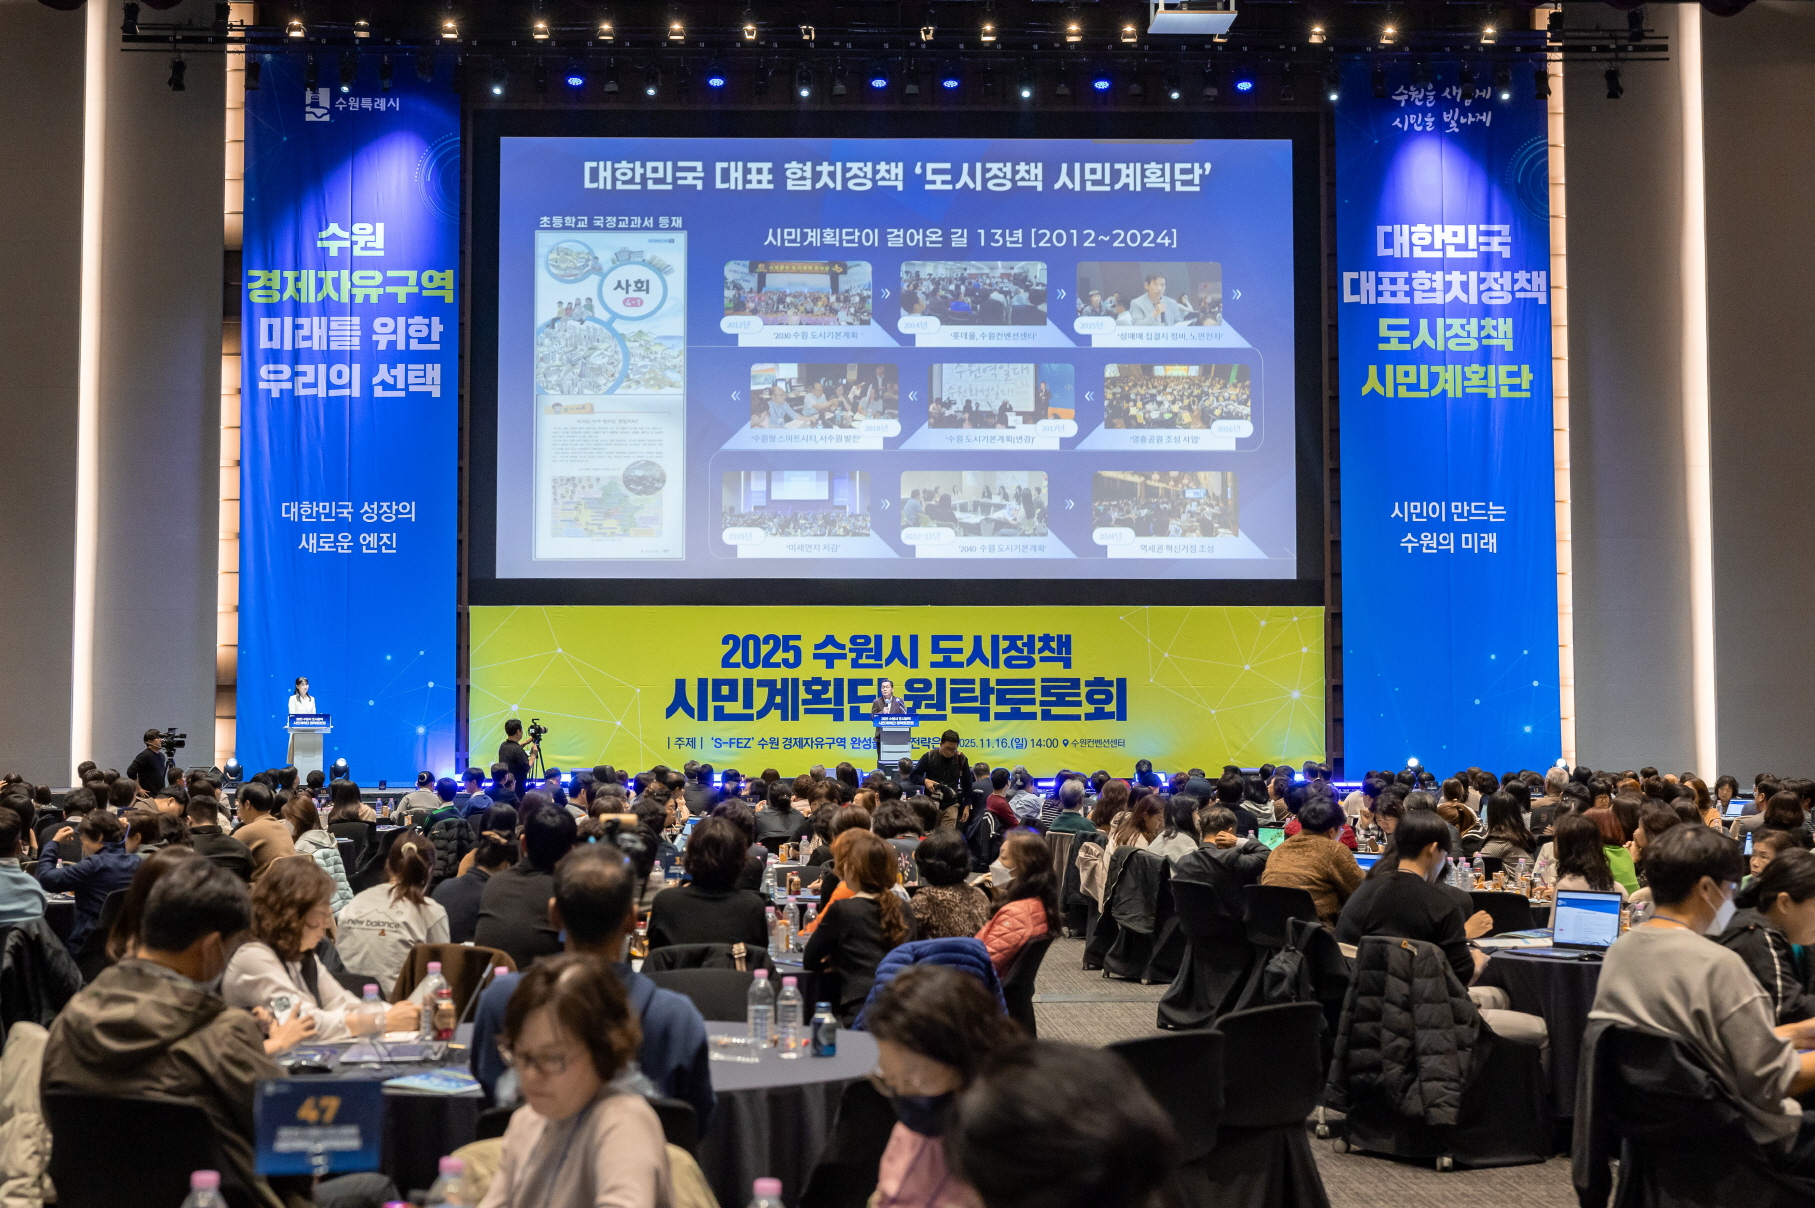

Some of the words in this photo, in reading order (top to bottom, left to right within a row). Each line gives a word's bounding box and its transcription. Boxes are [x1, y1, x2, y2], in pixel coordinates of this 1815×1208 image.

[335, 97, 400, 111] 수원특례시
[1392, 83, 1436, 107] 수원을
[1441, 85, 1492, 106] 새게
[1392, 113, 1435, 131] 시민을
[1443, 107, 1492, 133] 빛나게
[583, 161, 705, 191] 대한민국
[715, 161, 774, 192] 대표
[784, 161, 904, 192] 협치정책
[914, 161, 1044, 193] ‘도시정책
[1053, 161, 1213, 193] 시민계획단’
[539, 216, 588, 229] 초등학교
[592, 216, 654, 230] 국정교과서
[658, 216, 683, 230] 등재
[316, 222, 385, 257] 수원
[763, 227, 880, 248] 시민계획단이
[886, 227, 944, 248] 걸어온
[950, 227, 968, 248] 길
[977, 227, 1023, 248] 13년
[1030, 228, 1178, 250] [2012~2024]
[1376, 223, 1512, 259] 대한민국
[247, 269, 454, 304] 경제자유구역
[613, 279, 650, 295] 사회
[1342, 270, 1547, 305] 대표협치정책
[625, 298, 641, 307] 4-1
[259, 316, 361, 351] 미래를
[372, 316, 443, 351] 위한
[726, 321, 751, 330] 2012년
[793, 331, 809, 340] 수원
[903, 321, 928, 330] 2014년
[1080, 321, 1104, 330] 2015년
[1378, 317, 1514, 352] 도시정책
[259, 363, 361, 398] 우리의
[372, 363, 441, 398] 선택
[1361, 364, 1533, 398] 시민계획단
[1041, 424, 1065, 433] 2017년
[1165, 435, 1181, 444] 조성
[281, 501, 354, 523] 대한민국
[359, 501, 416, 523] 성장의
[1390, 501, 1446, 523] 시민이
[1451, 501, 1507, 522] 만드는
[298, 532, 354, 554] 새로운
[359, 532, 397, 554] 엔진
[979, 544, 996, 553] 수원
[1198, 544, 1215, 554] 조성
[1400, 532, 1455, 554] 수원의
[1461, 532, 1497, 554] 미래
[721, 634, 802, 669] 2025
[812, 634, 919, 669] 수원시
[929, 634, 1072, 669] 도시정책
[665, 677, 888, 722] 시민계획단
[903, 676, 1128, 722] 원탁토론회
[674, 737, 696, 749] 주제
[711, 737, 755, 749] ‘S-FEZ’
[757, 737, 779, 750] 수원
[782, 737, 847, 750] 경제자유구역
[959, 737, 1028, 750] 025.11.16.(일)
[1031, 738, 1059, 749] 14:00
[1071, 738, 1126, 748] 수원컨벤션센터
[366, 919, 401, 929] balance
[297, 1096, 341, 1124] 47
